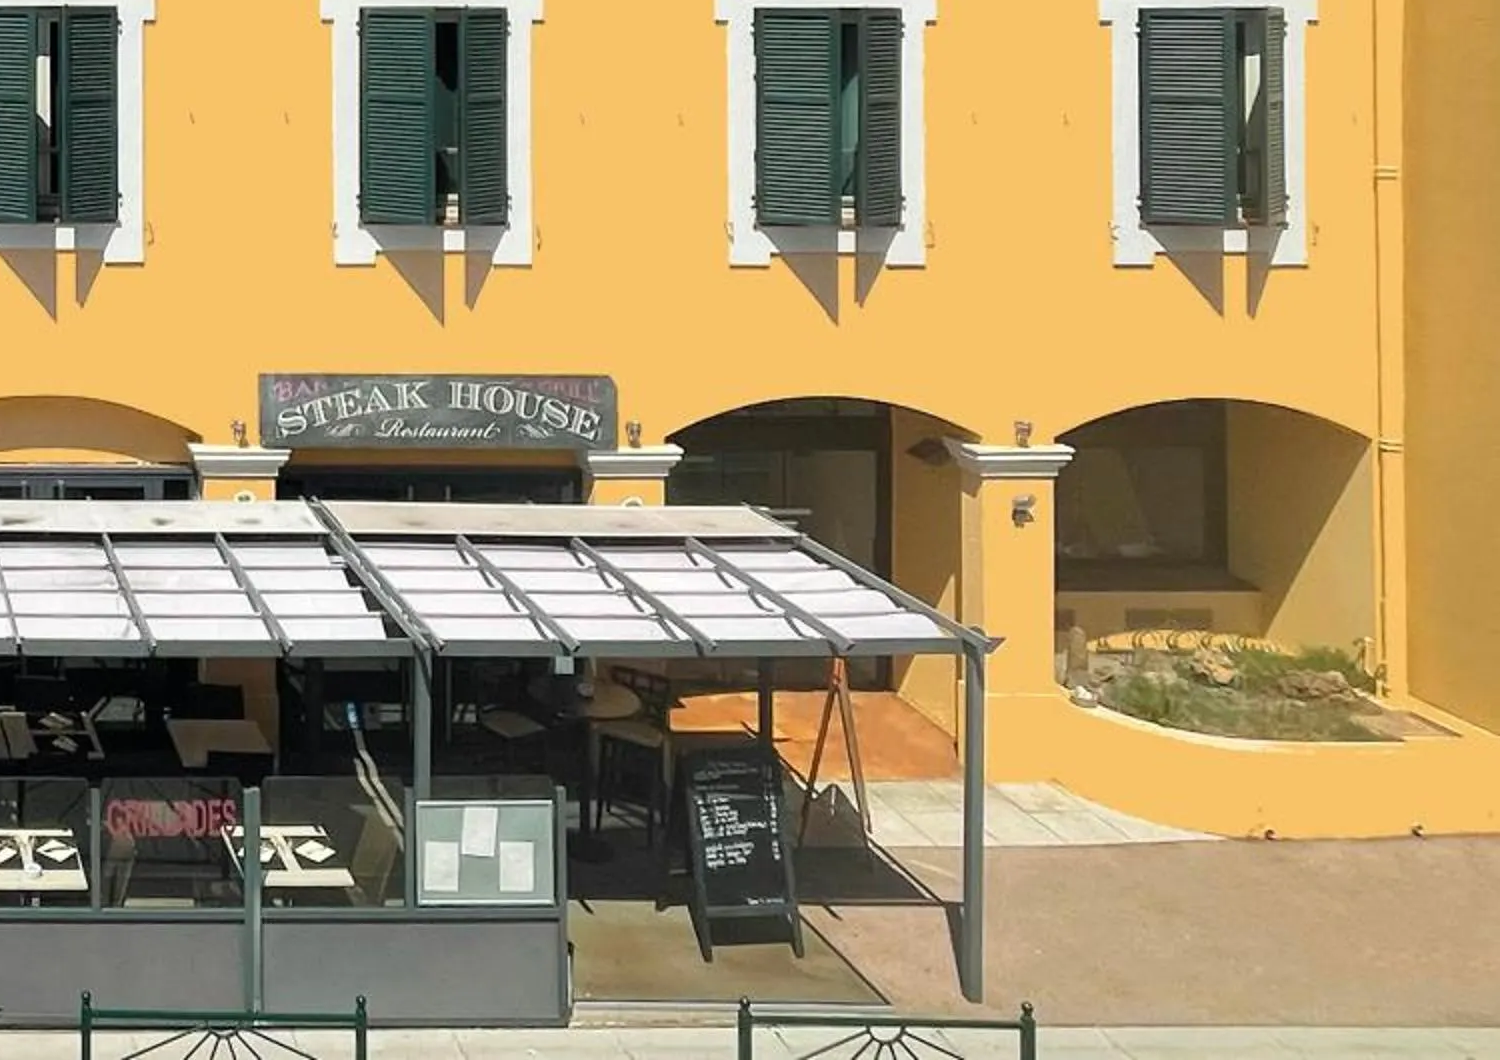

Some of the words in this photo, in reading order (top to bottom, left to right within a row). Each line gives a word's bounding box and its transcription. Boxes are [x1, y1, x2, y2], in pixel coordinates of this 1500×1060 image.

[277, 381, 430, 438] STEAK
[448, 381, 602, 441] HOUSE
[373, 418, 501, 440] Restaurant
